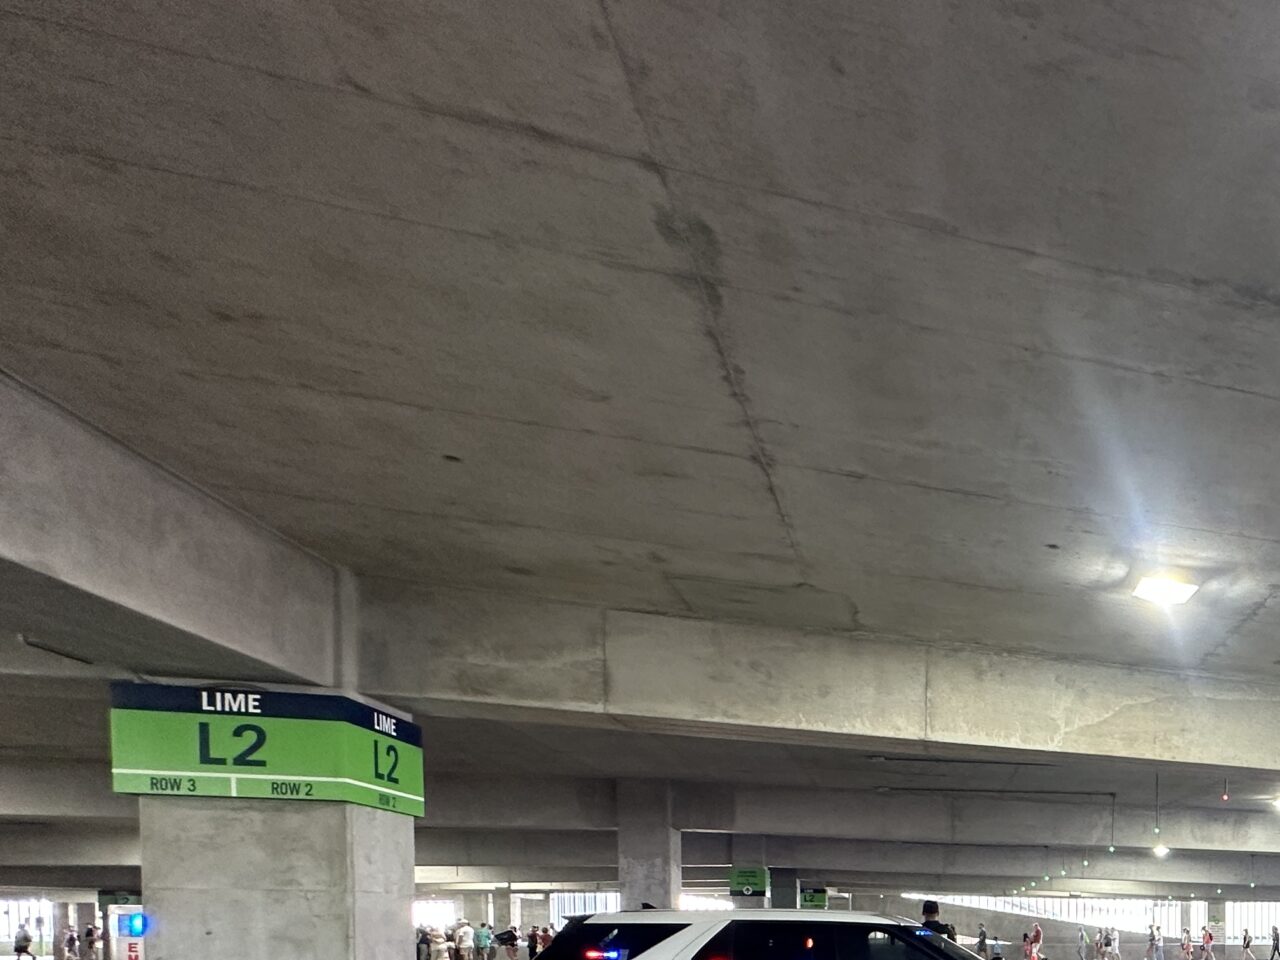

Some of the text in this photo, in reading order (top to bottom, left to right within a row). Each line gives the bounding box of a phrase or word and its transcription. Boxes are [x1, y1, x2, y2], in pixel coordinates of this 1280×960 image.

[201, 691, 262, 714] LIME
[373, 712, 397, 736] LIME
[198, 721, 268, 767] L2
[373, 739, 399, 785] L2
[150, 777, 197, 792] ROW 3
[271, 782, 313, 796] ROW 2
[804, 894, 815, 903] L2
